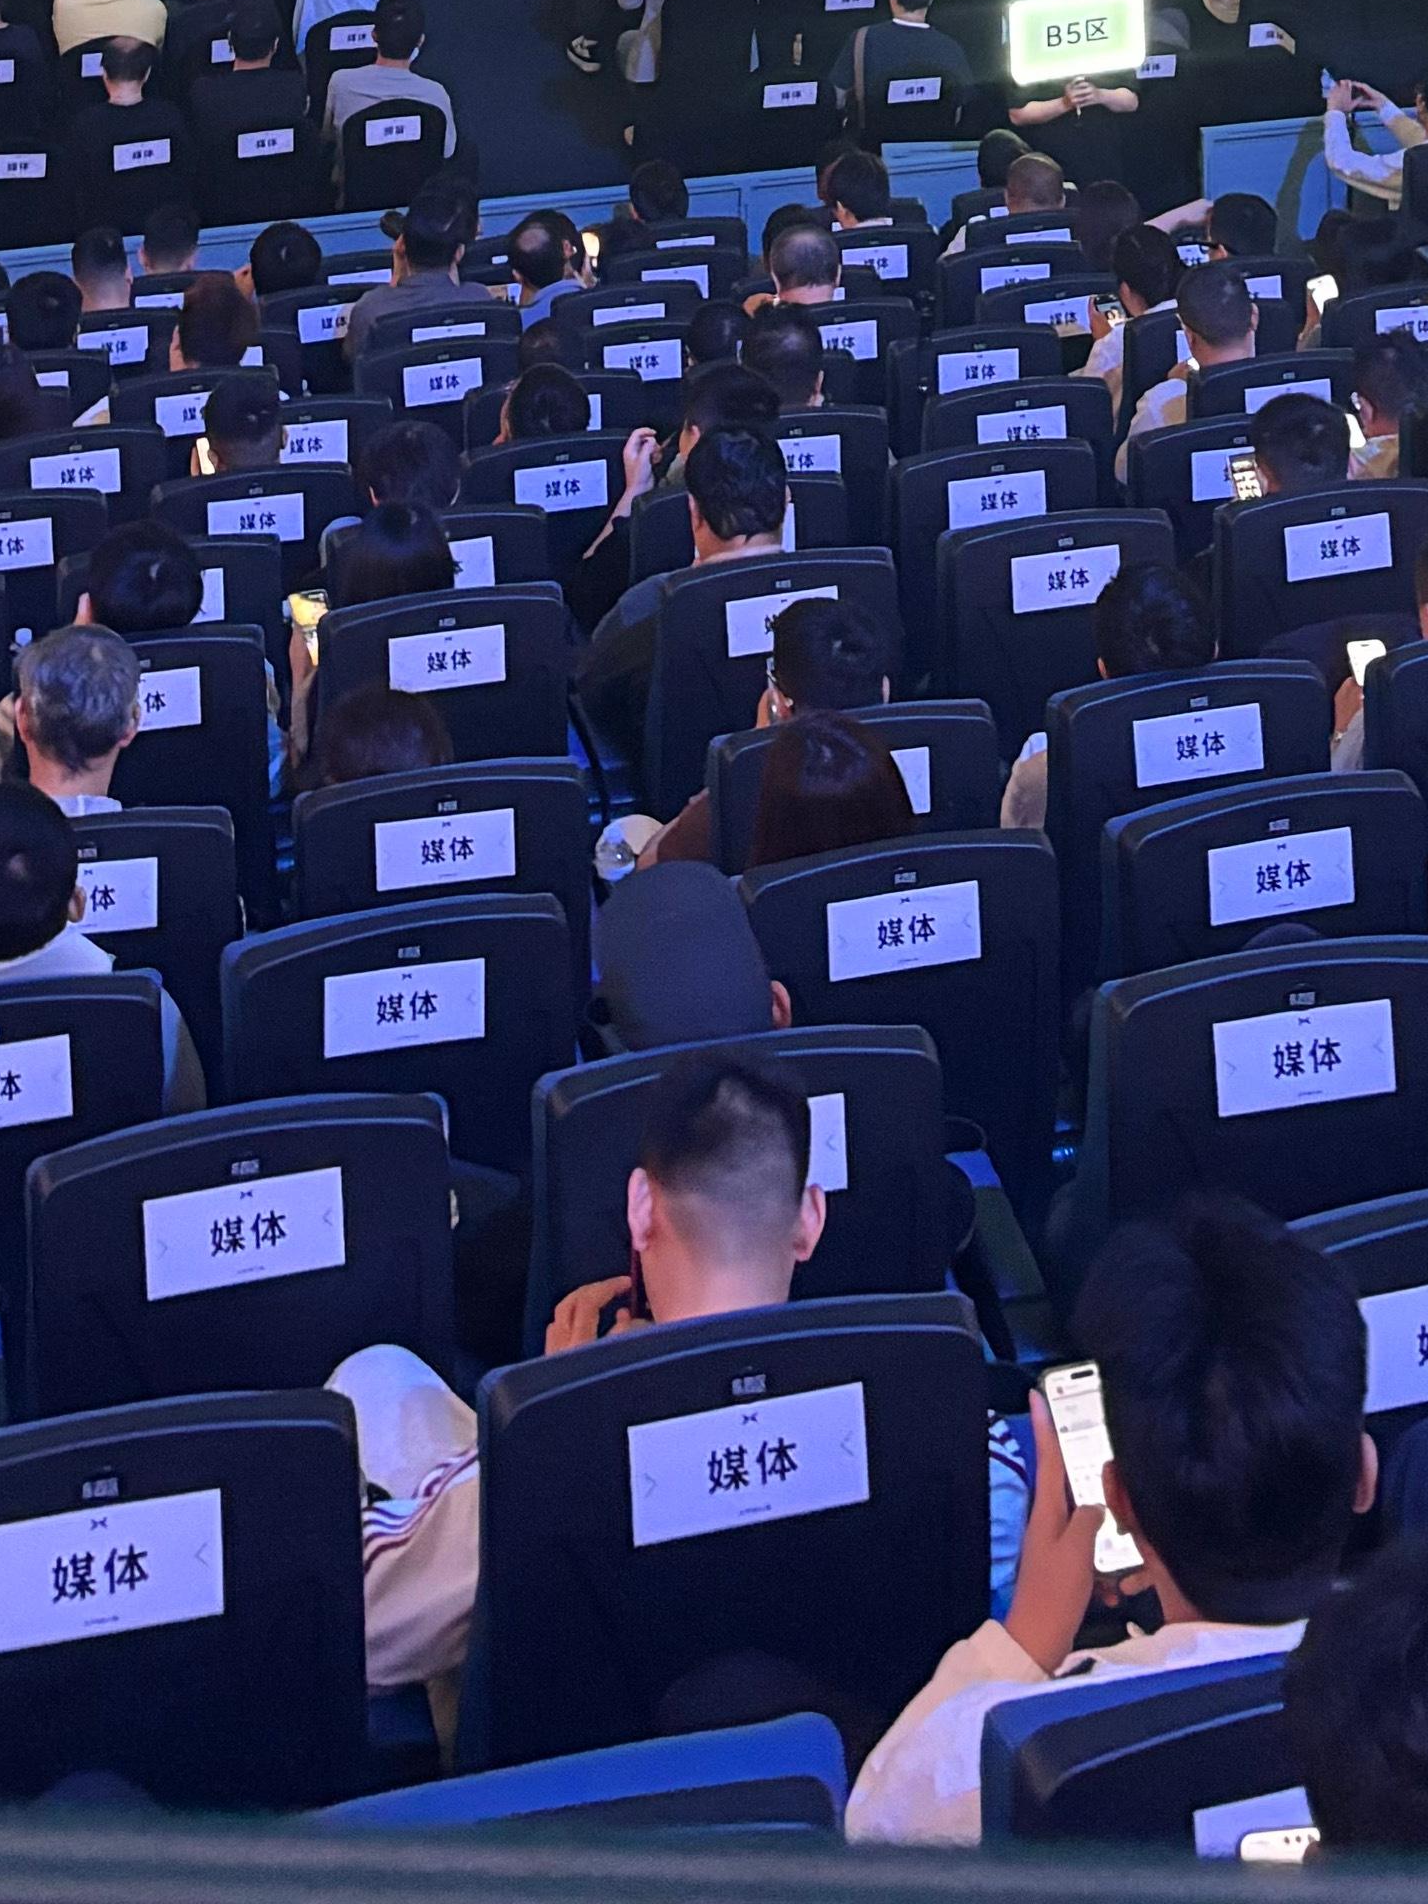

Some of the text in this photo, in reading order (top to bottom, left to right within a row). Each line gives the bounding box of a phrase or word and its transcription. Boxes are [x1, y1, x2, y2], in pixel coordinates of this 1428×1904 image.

[1047, 17, 1109, 47] B5区
[429, 375, 461, 391] 媒体
[965, 364, 996, 380] 媒体
[1007, 425, 1041, 442] 媒体
[290, 438, 323, 455] 媒体
[61, 467, 95, 485] 媒体
[546, 479, 580, 498] 媒体
[981, 491, 1018, 511] 媒体
[240, 512, 276, 530] 媒体
[1320, 536, 1360, 560] 媒体
[1048, 568, 1089, 591] 媒体
[428, 648, 471, 673] 媒体
[1176, 731, 1225, 760] 媒体
[422, 836, 474, 865] 媒体
[1256, 859, 1311, 894] 媒体
[878, 913, 935, 949] 媒体
[377, 990, 437, 1025] 媒体
[1273, 1037, 1341, 1079] 媒体
[210, 1210, 286, 1257] 媒体
[708, 1437, 798, 1495] 媒体
[52, 1544, 148, 1604] 媒体
